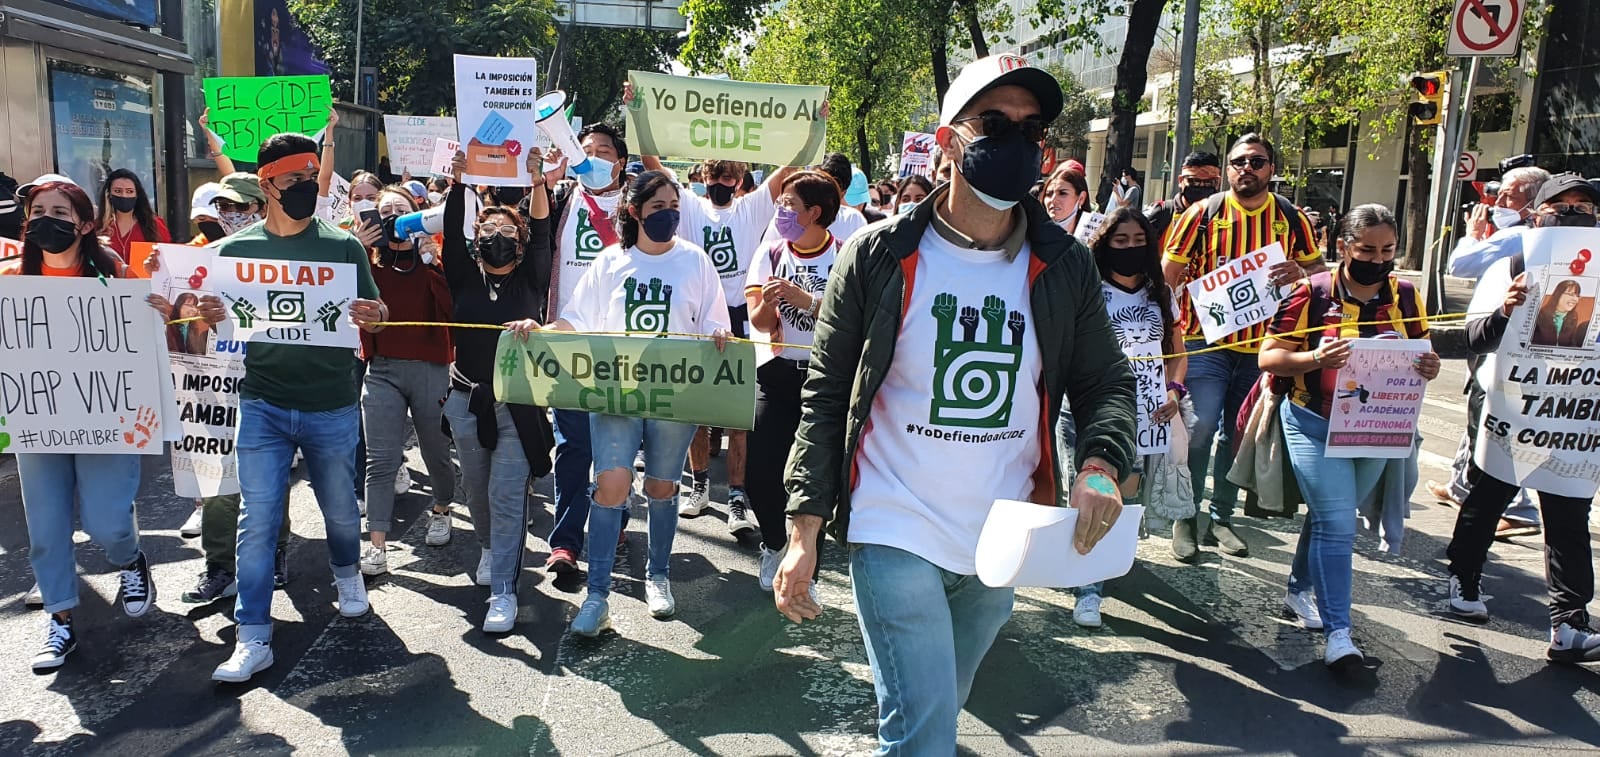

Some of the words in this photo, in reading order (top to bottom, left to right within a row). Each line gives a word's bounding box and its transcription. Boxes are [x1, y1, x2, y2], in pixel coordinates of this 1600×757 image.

[475, 72, 487, 81] LA
[489, 72, 532, 82] IMPOSICIÓN
[216, 84, 249, 111] EL
[256, 80, 323, 113] CIDE
[484, 86, 520, 96] TAMBIÉN
[522, 88, 532, 96] ES
[483, 100, 532, 110] CORRUPCIÓN
[652, 88, 677, 111] Yo
[685, 90, 787, 119] Defiendo
[793, 98, 818, 122] Al
[689, 118, 763, 152] CIDE
[235, 262, 335, 286] UDLAP
[1202, 252, 1268, 293] UDLAP
[67, 295, 138, 353] SIGUE
[1234, 305, 1269, 327] CIDE
[266, 327, 312, 341] CIDE
[526, 350, 560, 378] Yo
[572, 352, 705, 385] Defiendo
[713, 359, 746, 386] Al
[1508, 365, 1538, 385] LA
[73, 370, 137, 414] VIVE
[1386, 378, 1406, 387] POR
[1409, 378, 1421, 387] LA
[578, 386, 675, 418] CIDE
[1371, 391, 1419, 401] LIBERTAD
[1359, 404, 1416, 415] ACADÉMICA
[906, 423, 1026, 443] #YoDefiendoalCIDE
[1344, 419, 1350, 428] Y
[1354, 419, 1412, 429] AUTONOMÍA
[1483, 413, 1511, 438] ES
[18, 429, 120, 449] #UDLAPLIBRE
[1334, 434, 1409, 444] UNIVERSITARIA
